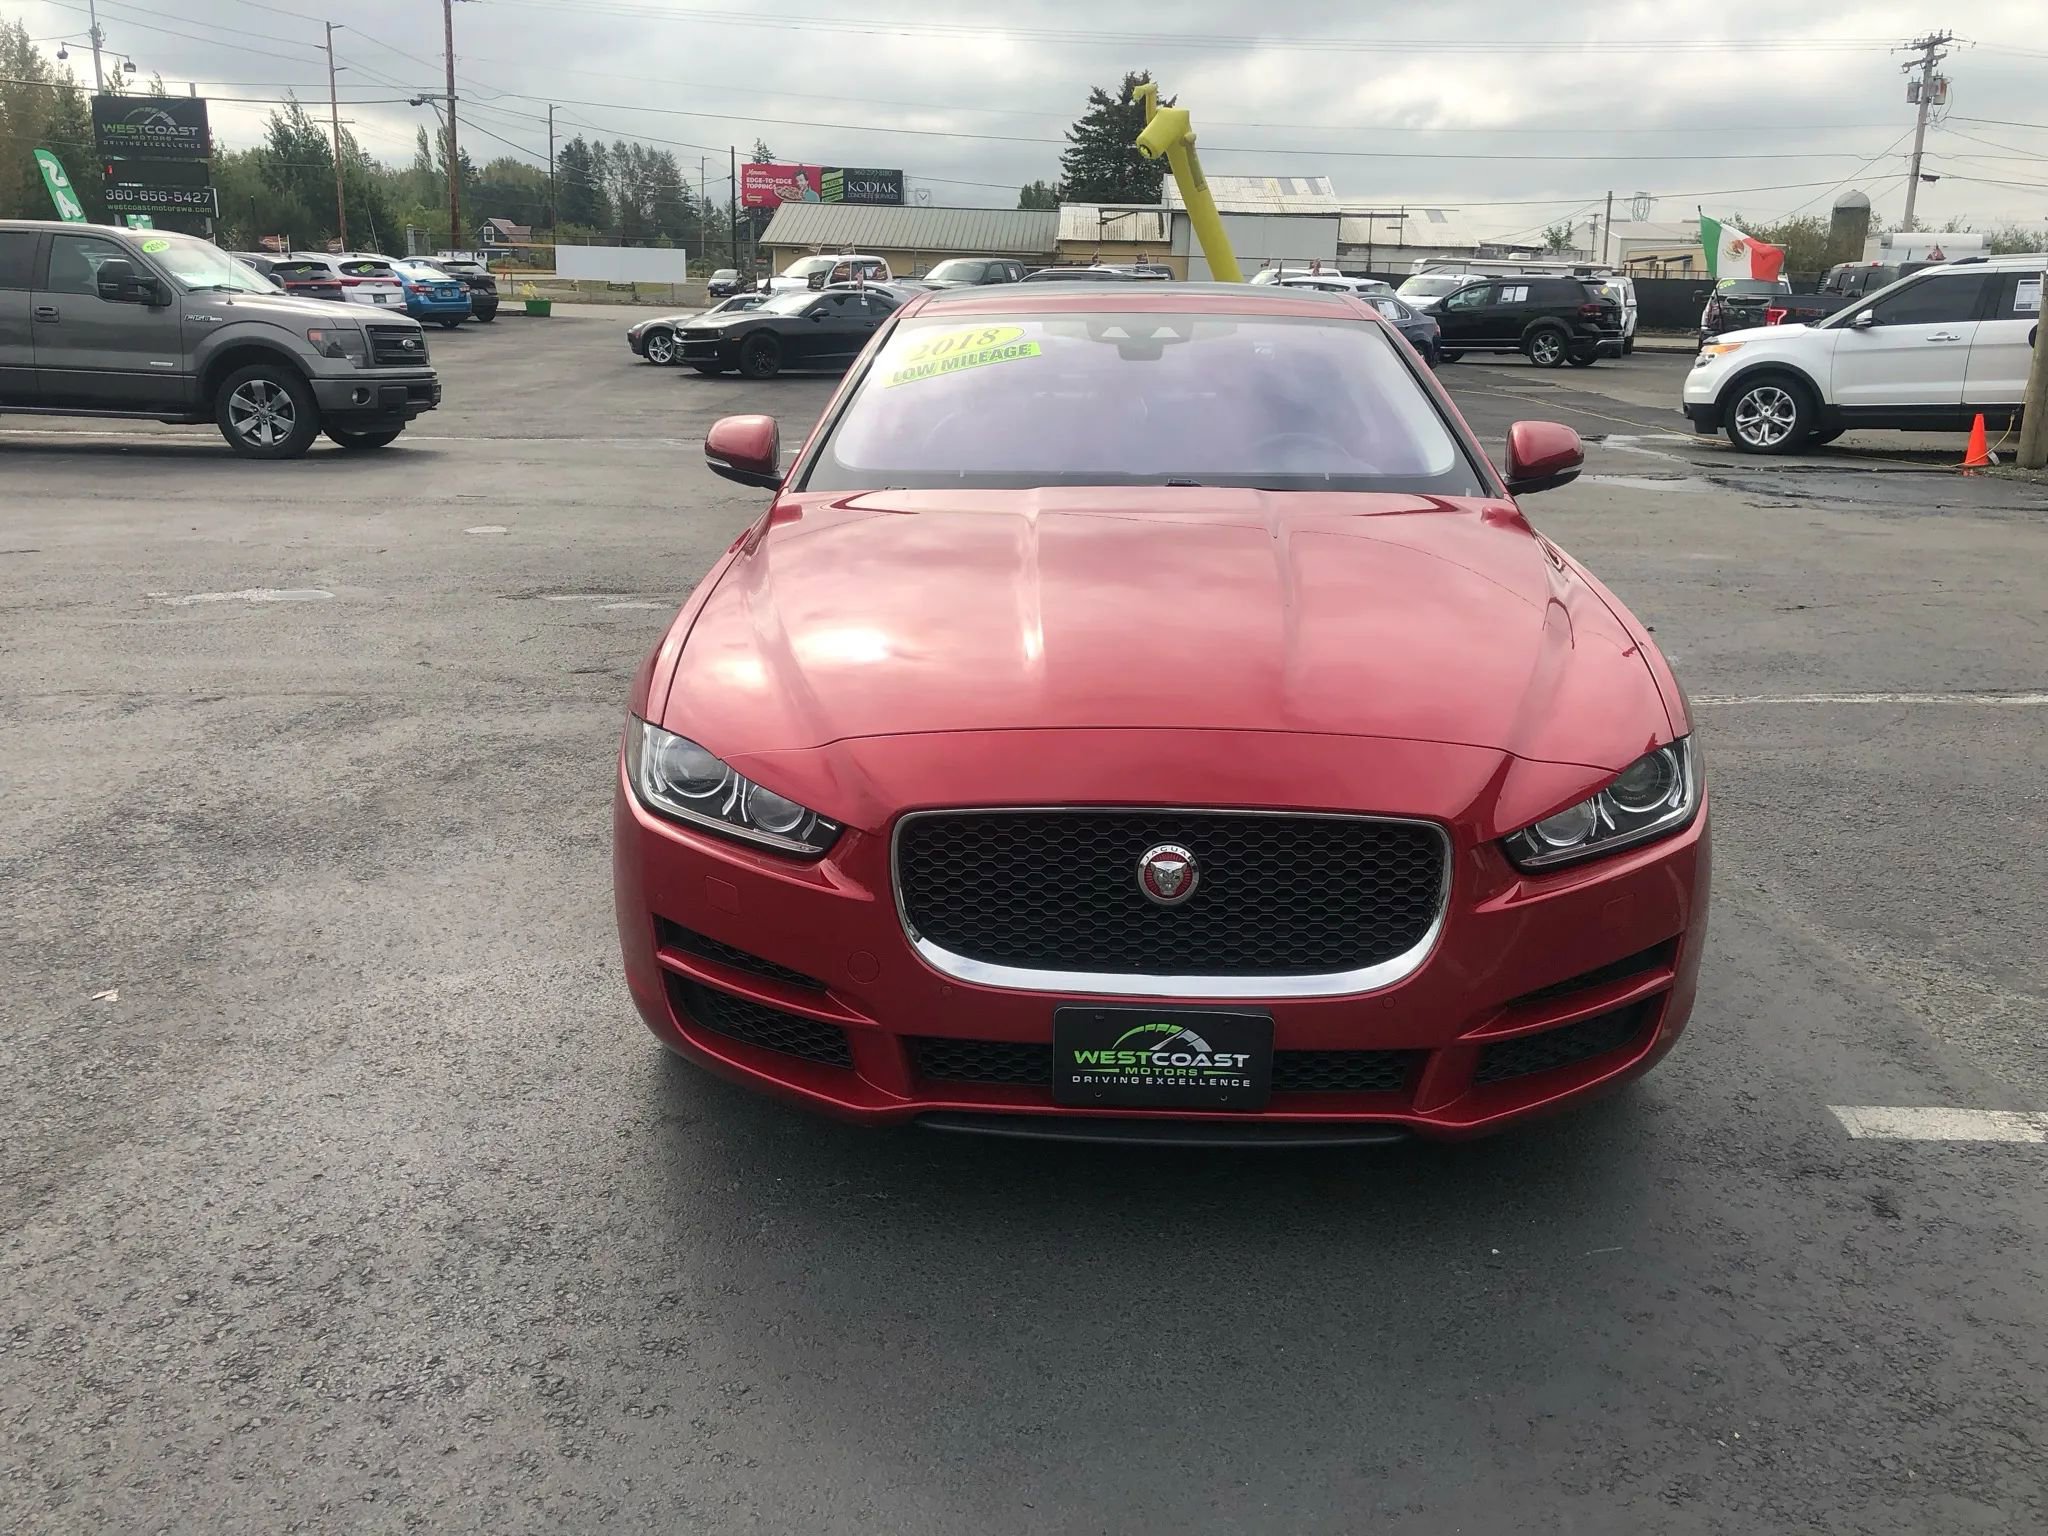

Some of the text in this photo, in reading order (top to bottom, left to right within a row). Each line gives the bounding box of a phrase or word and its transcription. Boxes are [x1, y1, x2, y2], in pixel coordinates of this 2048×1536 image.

[101, 123, 199, 136] WESTCOAST
[143, 141, 201, 149] EXCELLENCE
[746, 177, 792, 185] EDGE-TO-EDGE
[848, 181, 898, 193] KODIAK
[105, 189, 211, 203] 360-656-5427
[107, 203, 212, 213] westcoastmotorswa.com
[909, 328, 1000, 362] 2018
[893, 343, 1032, 383] LOW MILEAGE
[1144, 846, 1196, 865] JAGUAR
[1073, 1050, 1251, 1068] WESTCOAST
[1125, 1066, 1198, 1077] MOTORS
[1072, 1075, 1251, 1088] DRIVING EXCELLENCE
